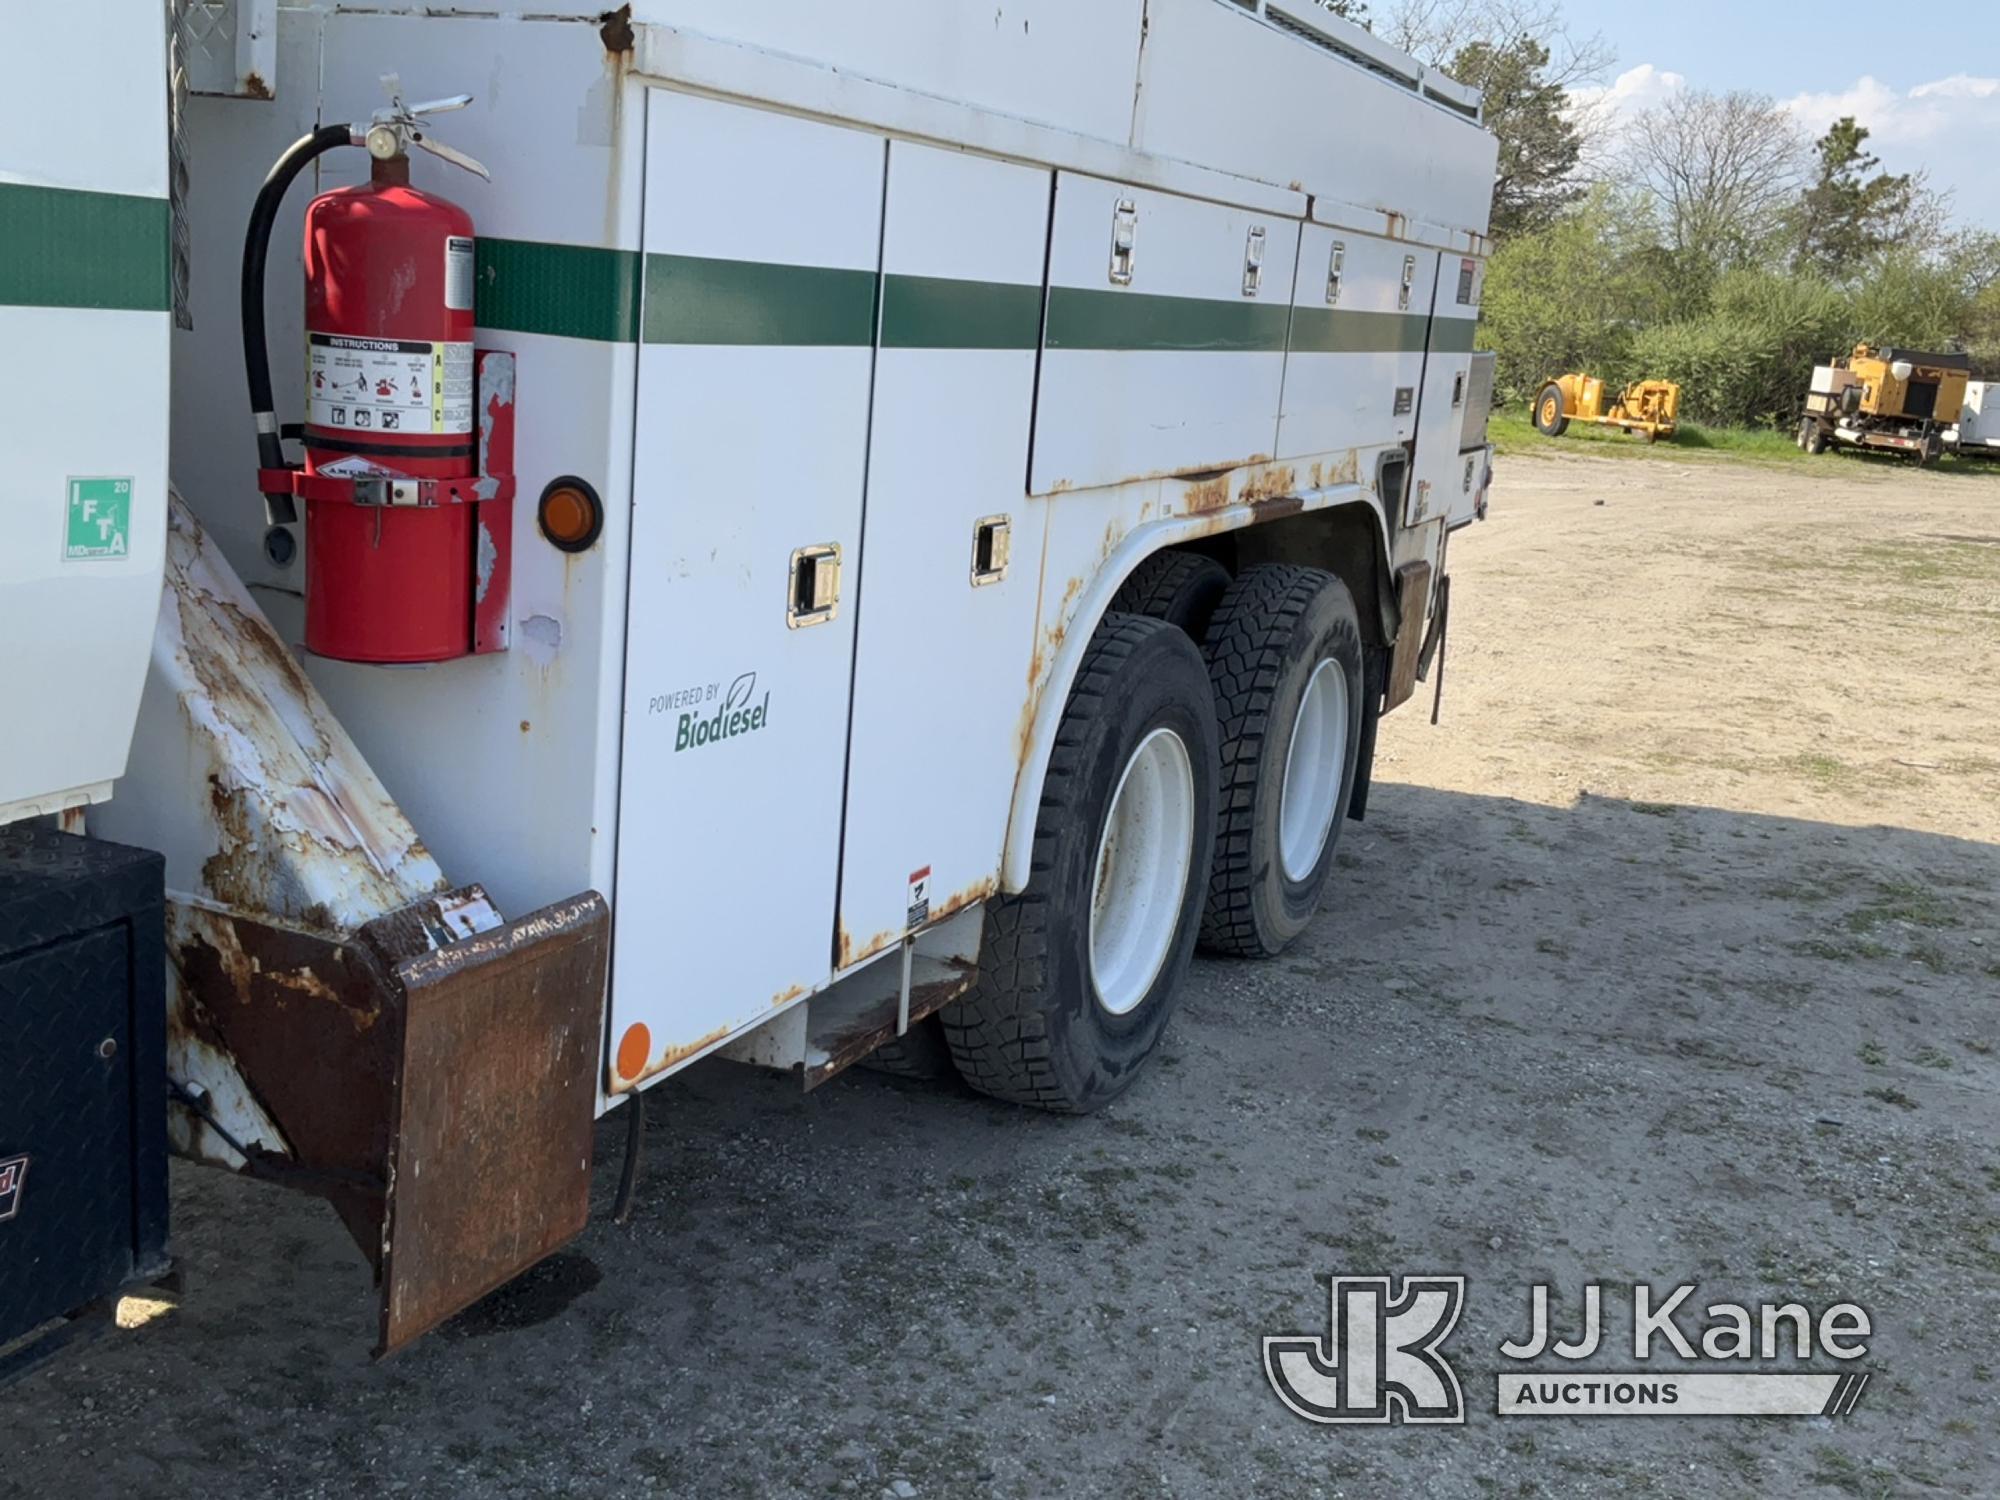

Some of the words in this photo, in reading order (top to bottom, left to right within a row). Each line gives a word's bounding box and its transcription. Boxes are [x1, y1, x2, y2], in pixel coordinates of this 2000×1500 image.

[330, 337, 399, 351] INSTRUCTIONS
[435, 354, 442, 367] A
[435, 382, 441, 394] B
[435, 409, 441, 421] C
[114, 482, 129, 493] 20
[649, 687, 703, 715] POWERED
[705, 683, 720, 701] BY
[674, 689, 770, 752] Biodiesel
